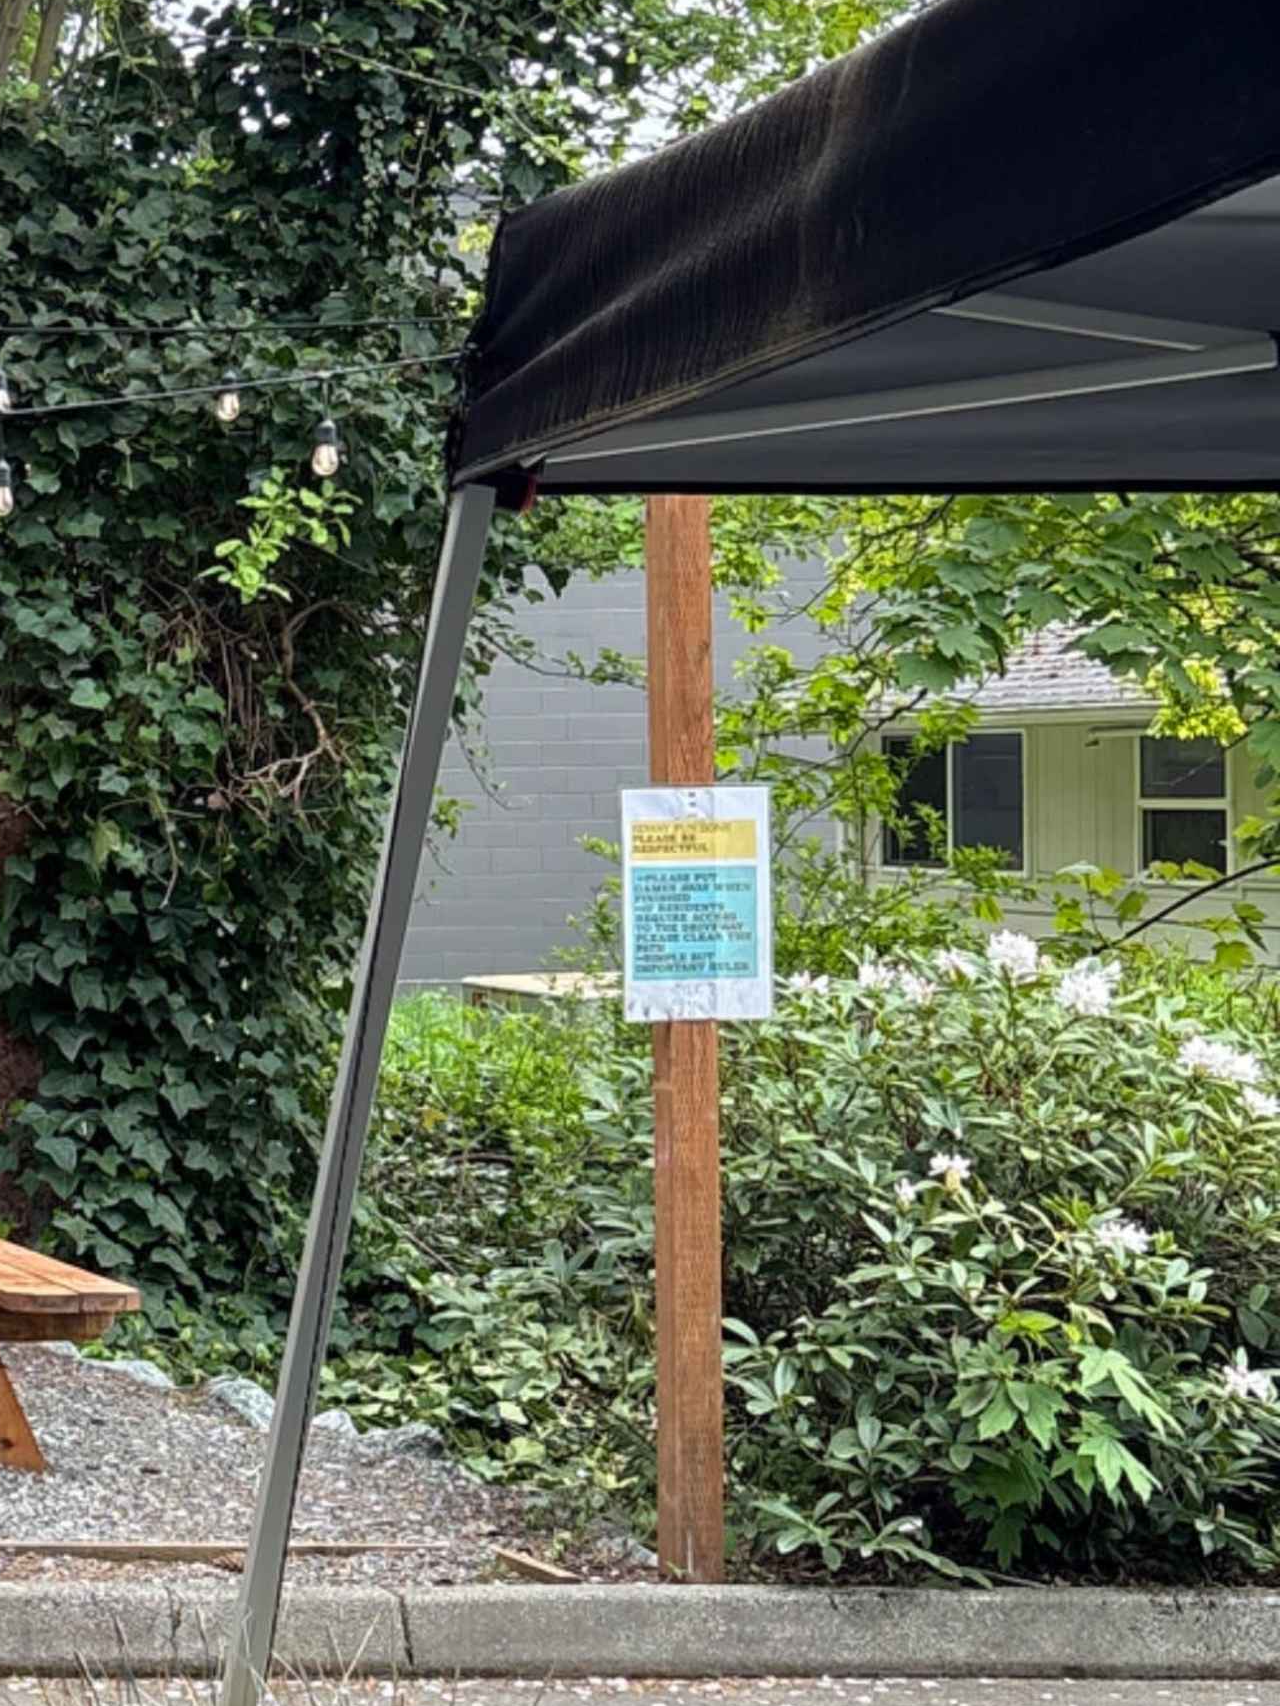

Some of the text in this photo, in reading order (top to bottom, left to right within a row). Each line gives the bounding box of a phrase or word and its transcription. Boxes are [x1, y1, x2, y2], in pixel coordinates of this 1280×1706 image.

[632, 834, 676, 843] PLEASE
[632, 843, 708, 853] RESPECTFUL
[658, 902, 725, 912] RESIDENTS
[635, 913, 687, 922] REQUIRE
[655, 924, 678, 932] THE
[635, 933, 679, 942] PLEASE
[634, 964, 705, 973] IMPORTANT
